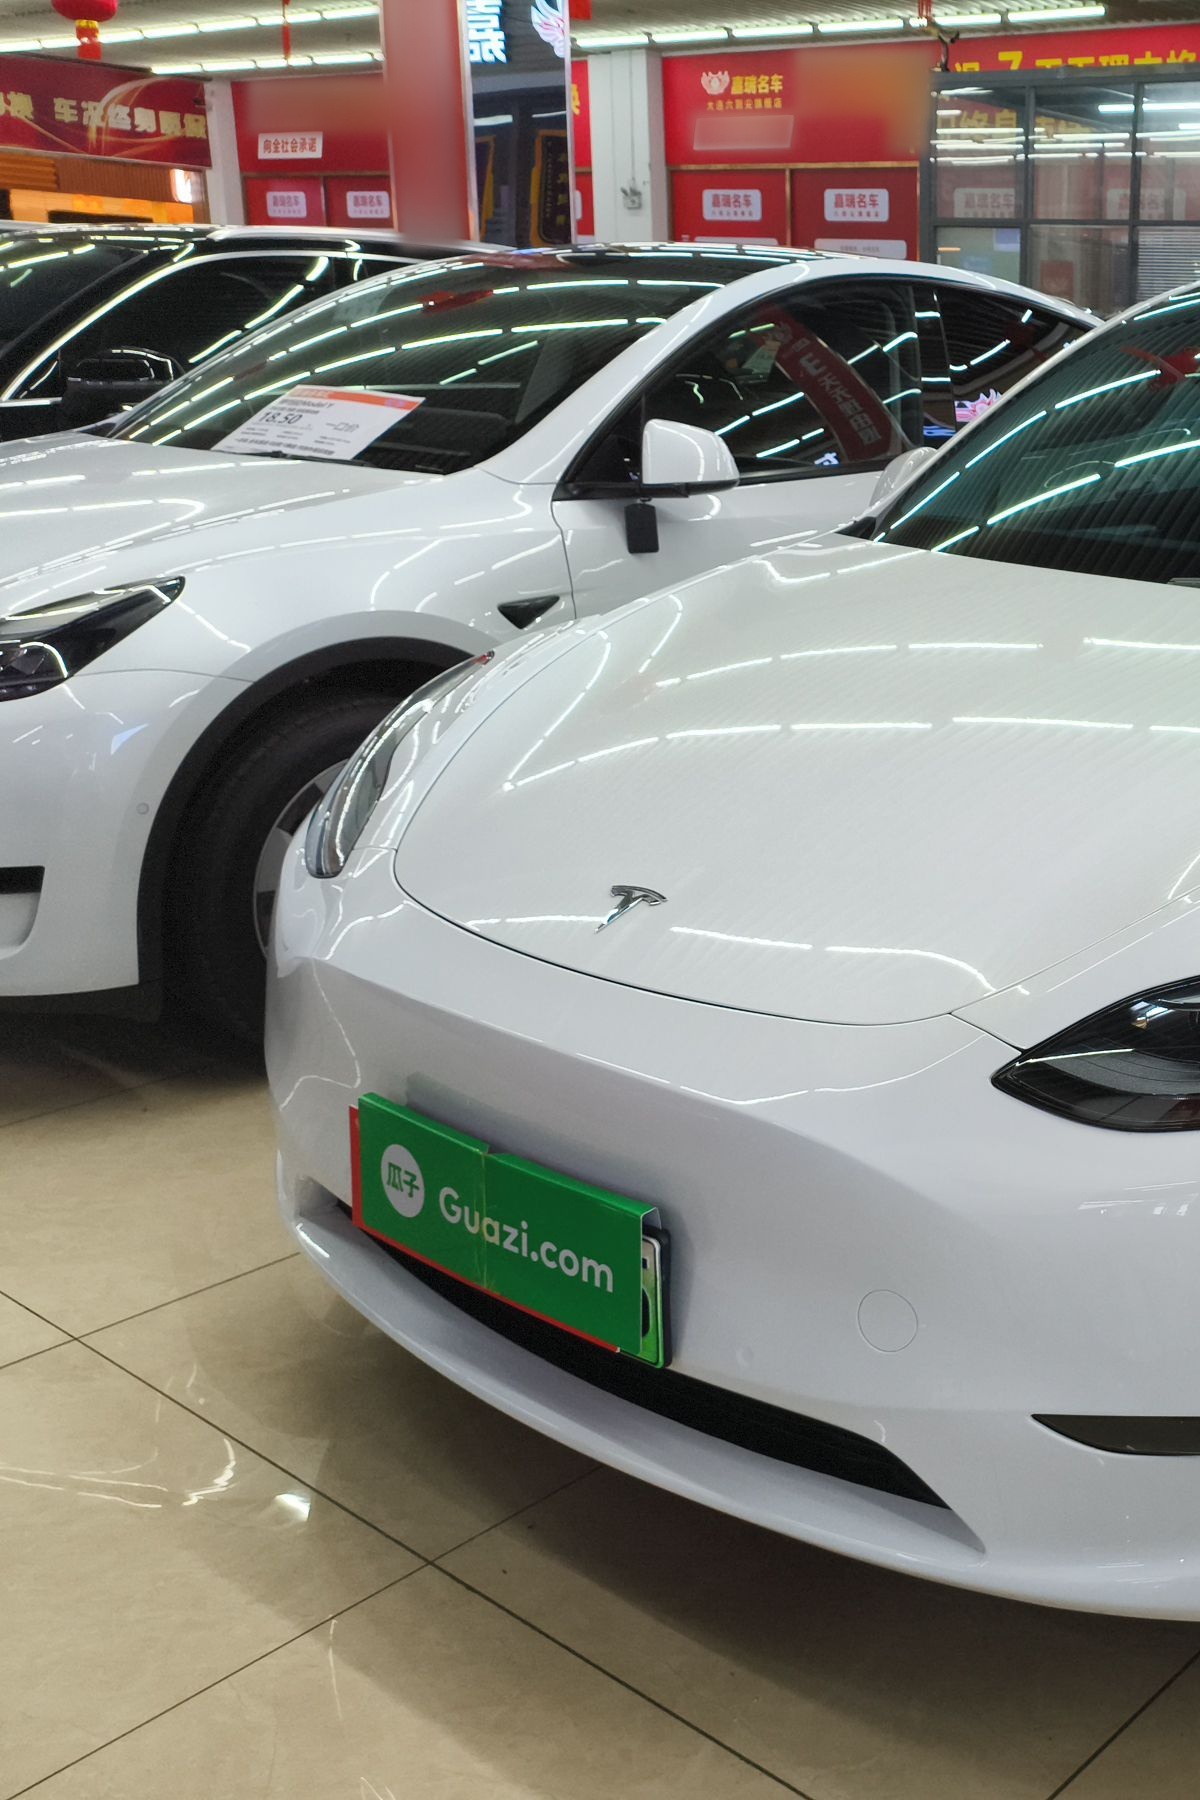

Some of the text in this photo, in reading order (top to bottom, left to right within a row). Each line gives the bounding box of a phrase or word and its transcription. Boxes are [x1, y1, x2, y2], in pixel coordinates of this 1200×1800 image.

[731, 74, 783, 94] 嘉瑞名车
[263, 137, 317, 153] 向全社会承诺
[712, 194, 753, 208] 嘉瑞名车
[834, 193, 879, 208] 嘉瑞名车
[386, 1161, 420, 1198] 瓜子
[438, 1186, 614, 1293] Guazi.com
